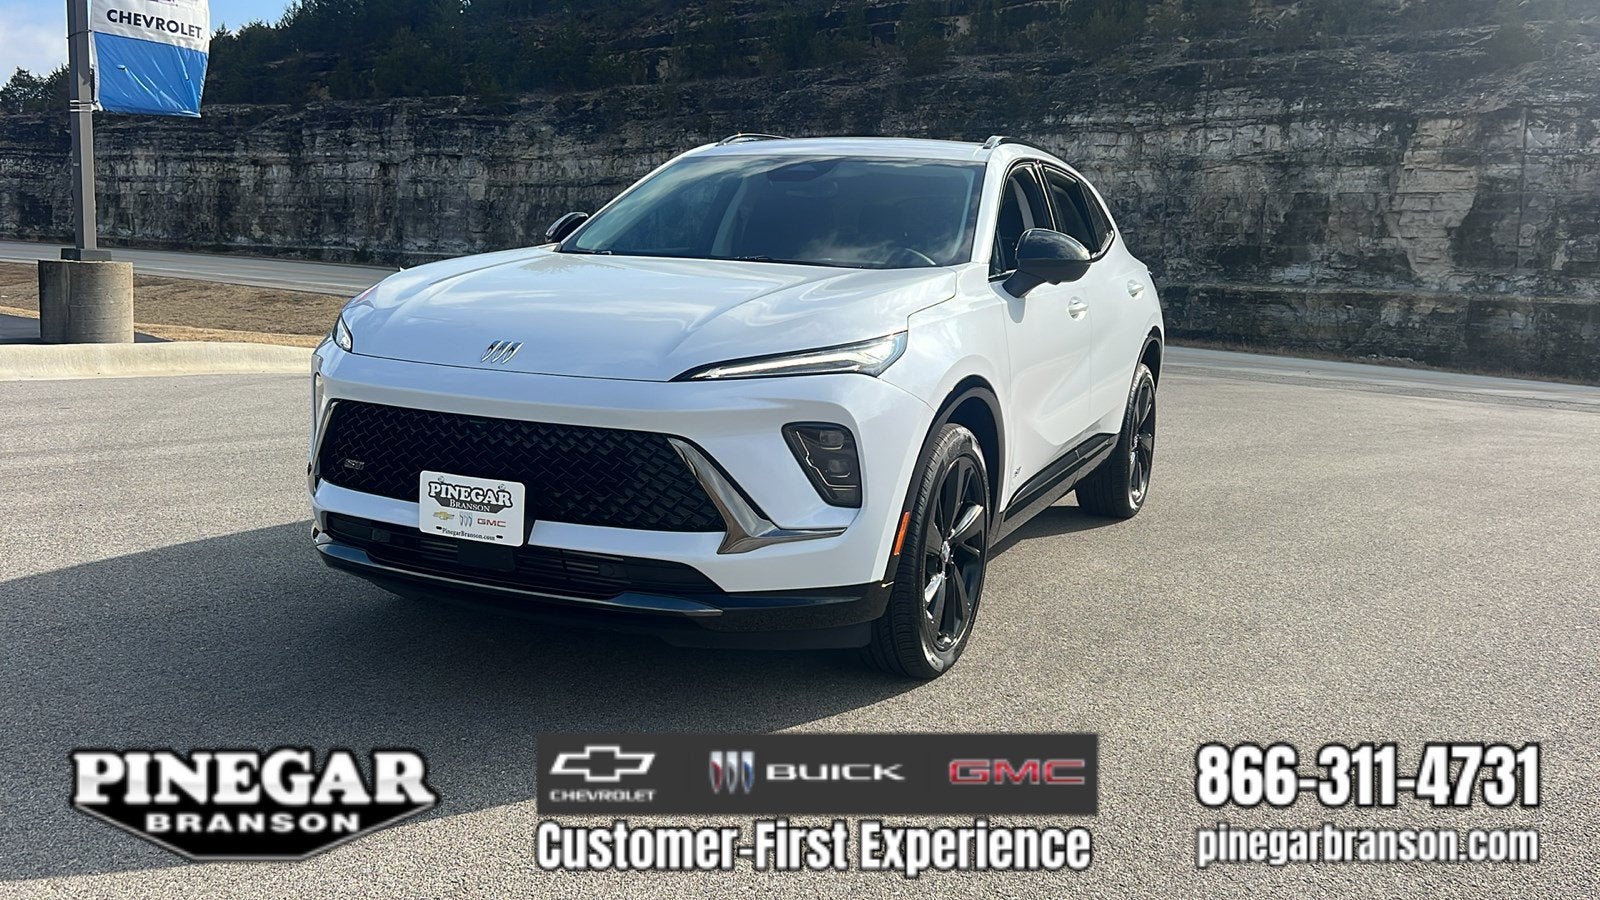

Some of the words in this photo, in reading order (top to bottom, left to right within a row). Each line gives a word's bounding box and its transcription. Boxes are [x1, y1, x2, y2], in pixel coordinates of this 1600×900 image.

[428, 482, 512, 507] PINEGAR
[449, 499, 491, 512] BRANSON
[477, 518, 507, 528] GMC
[441, 527, 496, 541] PinegarBranson.com
